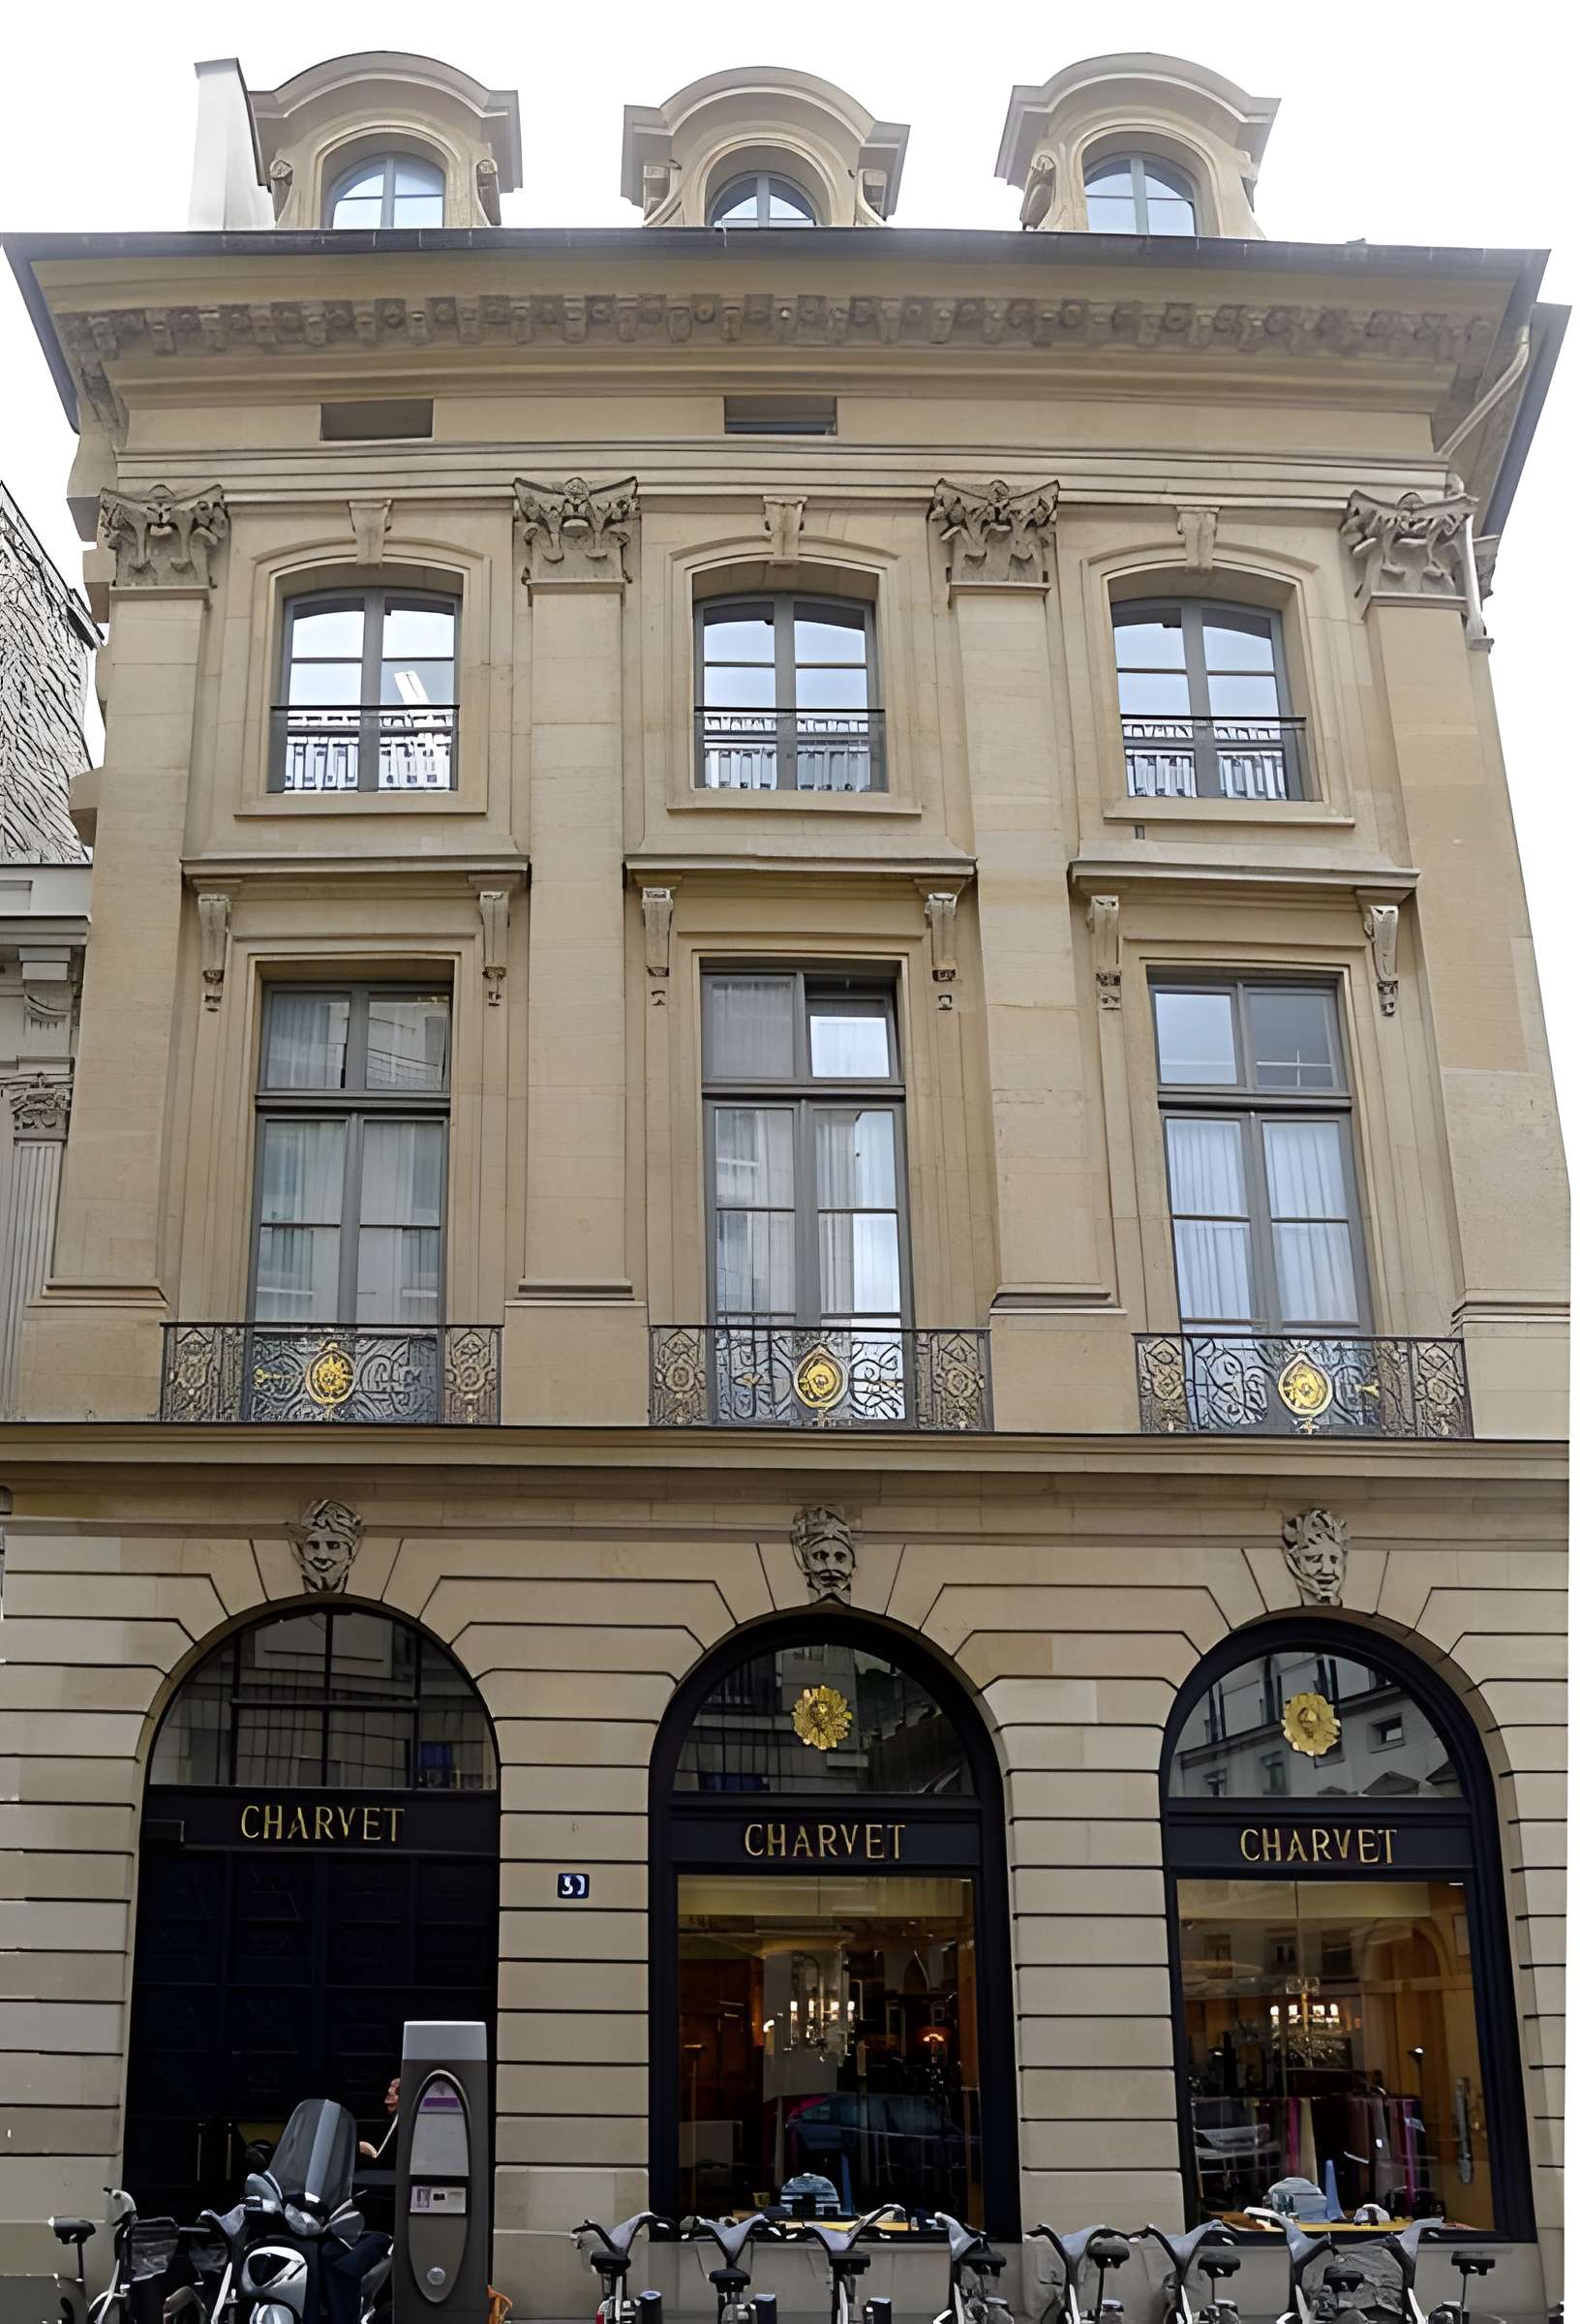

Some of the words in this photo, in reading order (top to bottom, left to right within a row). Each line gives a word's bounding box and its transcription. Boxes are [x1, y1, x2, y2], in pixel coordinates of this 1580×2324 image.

[241, 1805, 405, 1842] CHARVET
[744, 1823, 906, 1859] CHARVET
[1240, 1828, 1398, 1865] CHARVET
